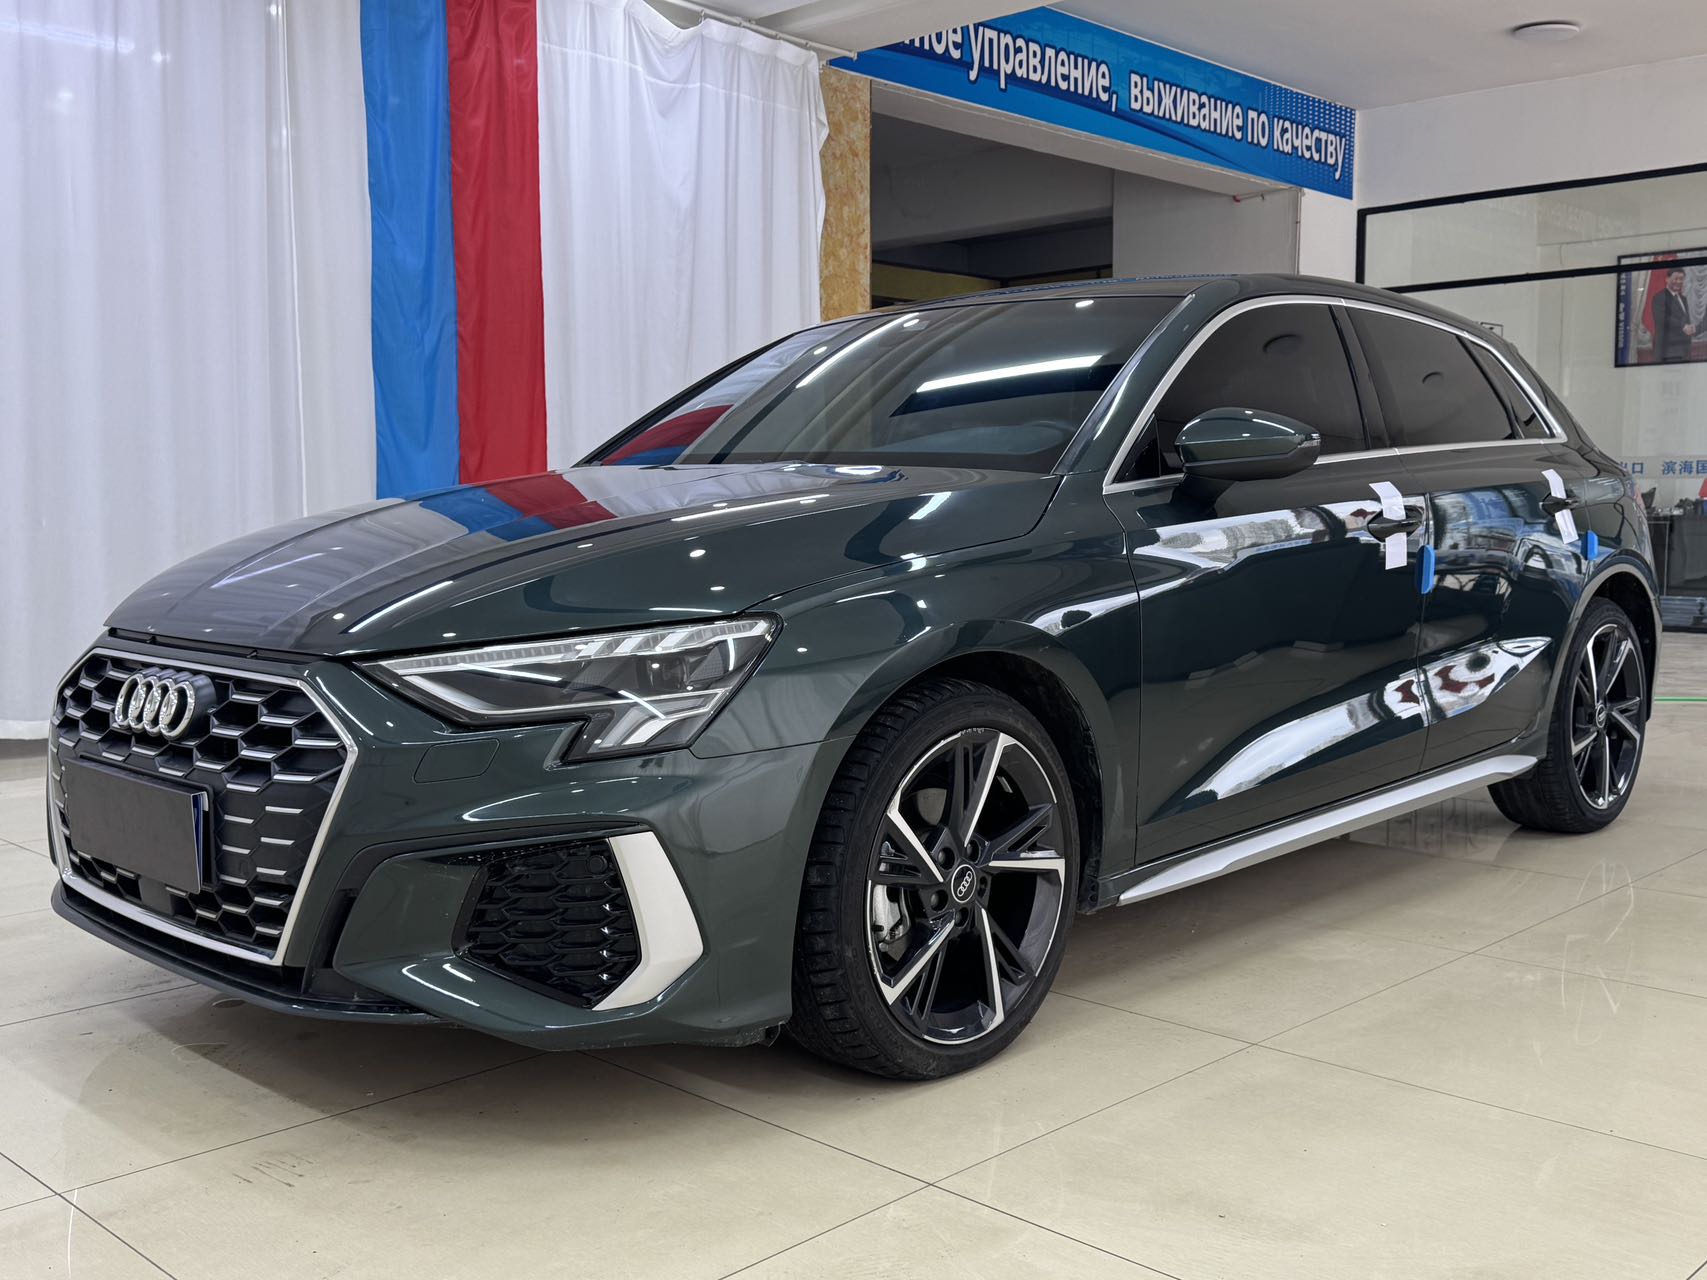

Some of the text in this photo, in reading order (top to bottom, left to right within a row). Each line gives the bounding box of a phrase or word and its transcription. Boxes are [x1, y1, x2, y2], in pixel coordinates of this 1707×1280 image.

[968, 24, 1118, 112] управление,
[1130, 73, 1243, 140] выживание
[1247, 109, 1269, 147] по
[1273, 117, 1346, 180] качеству
